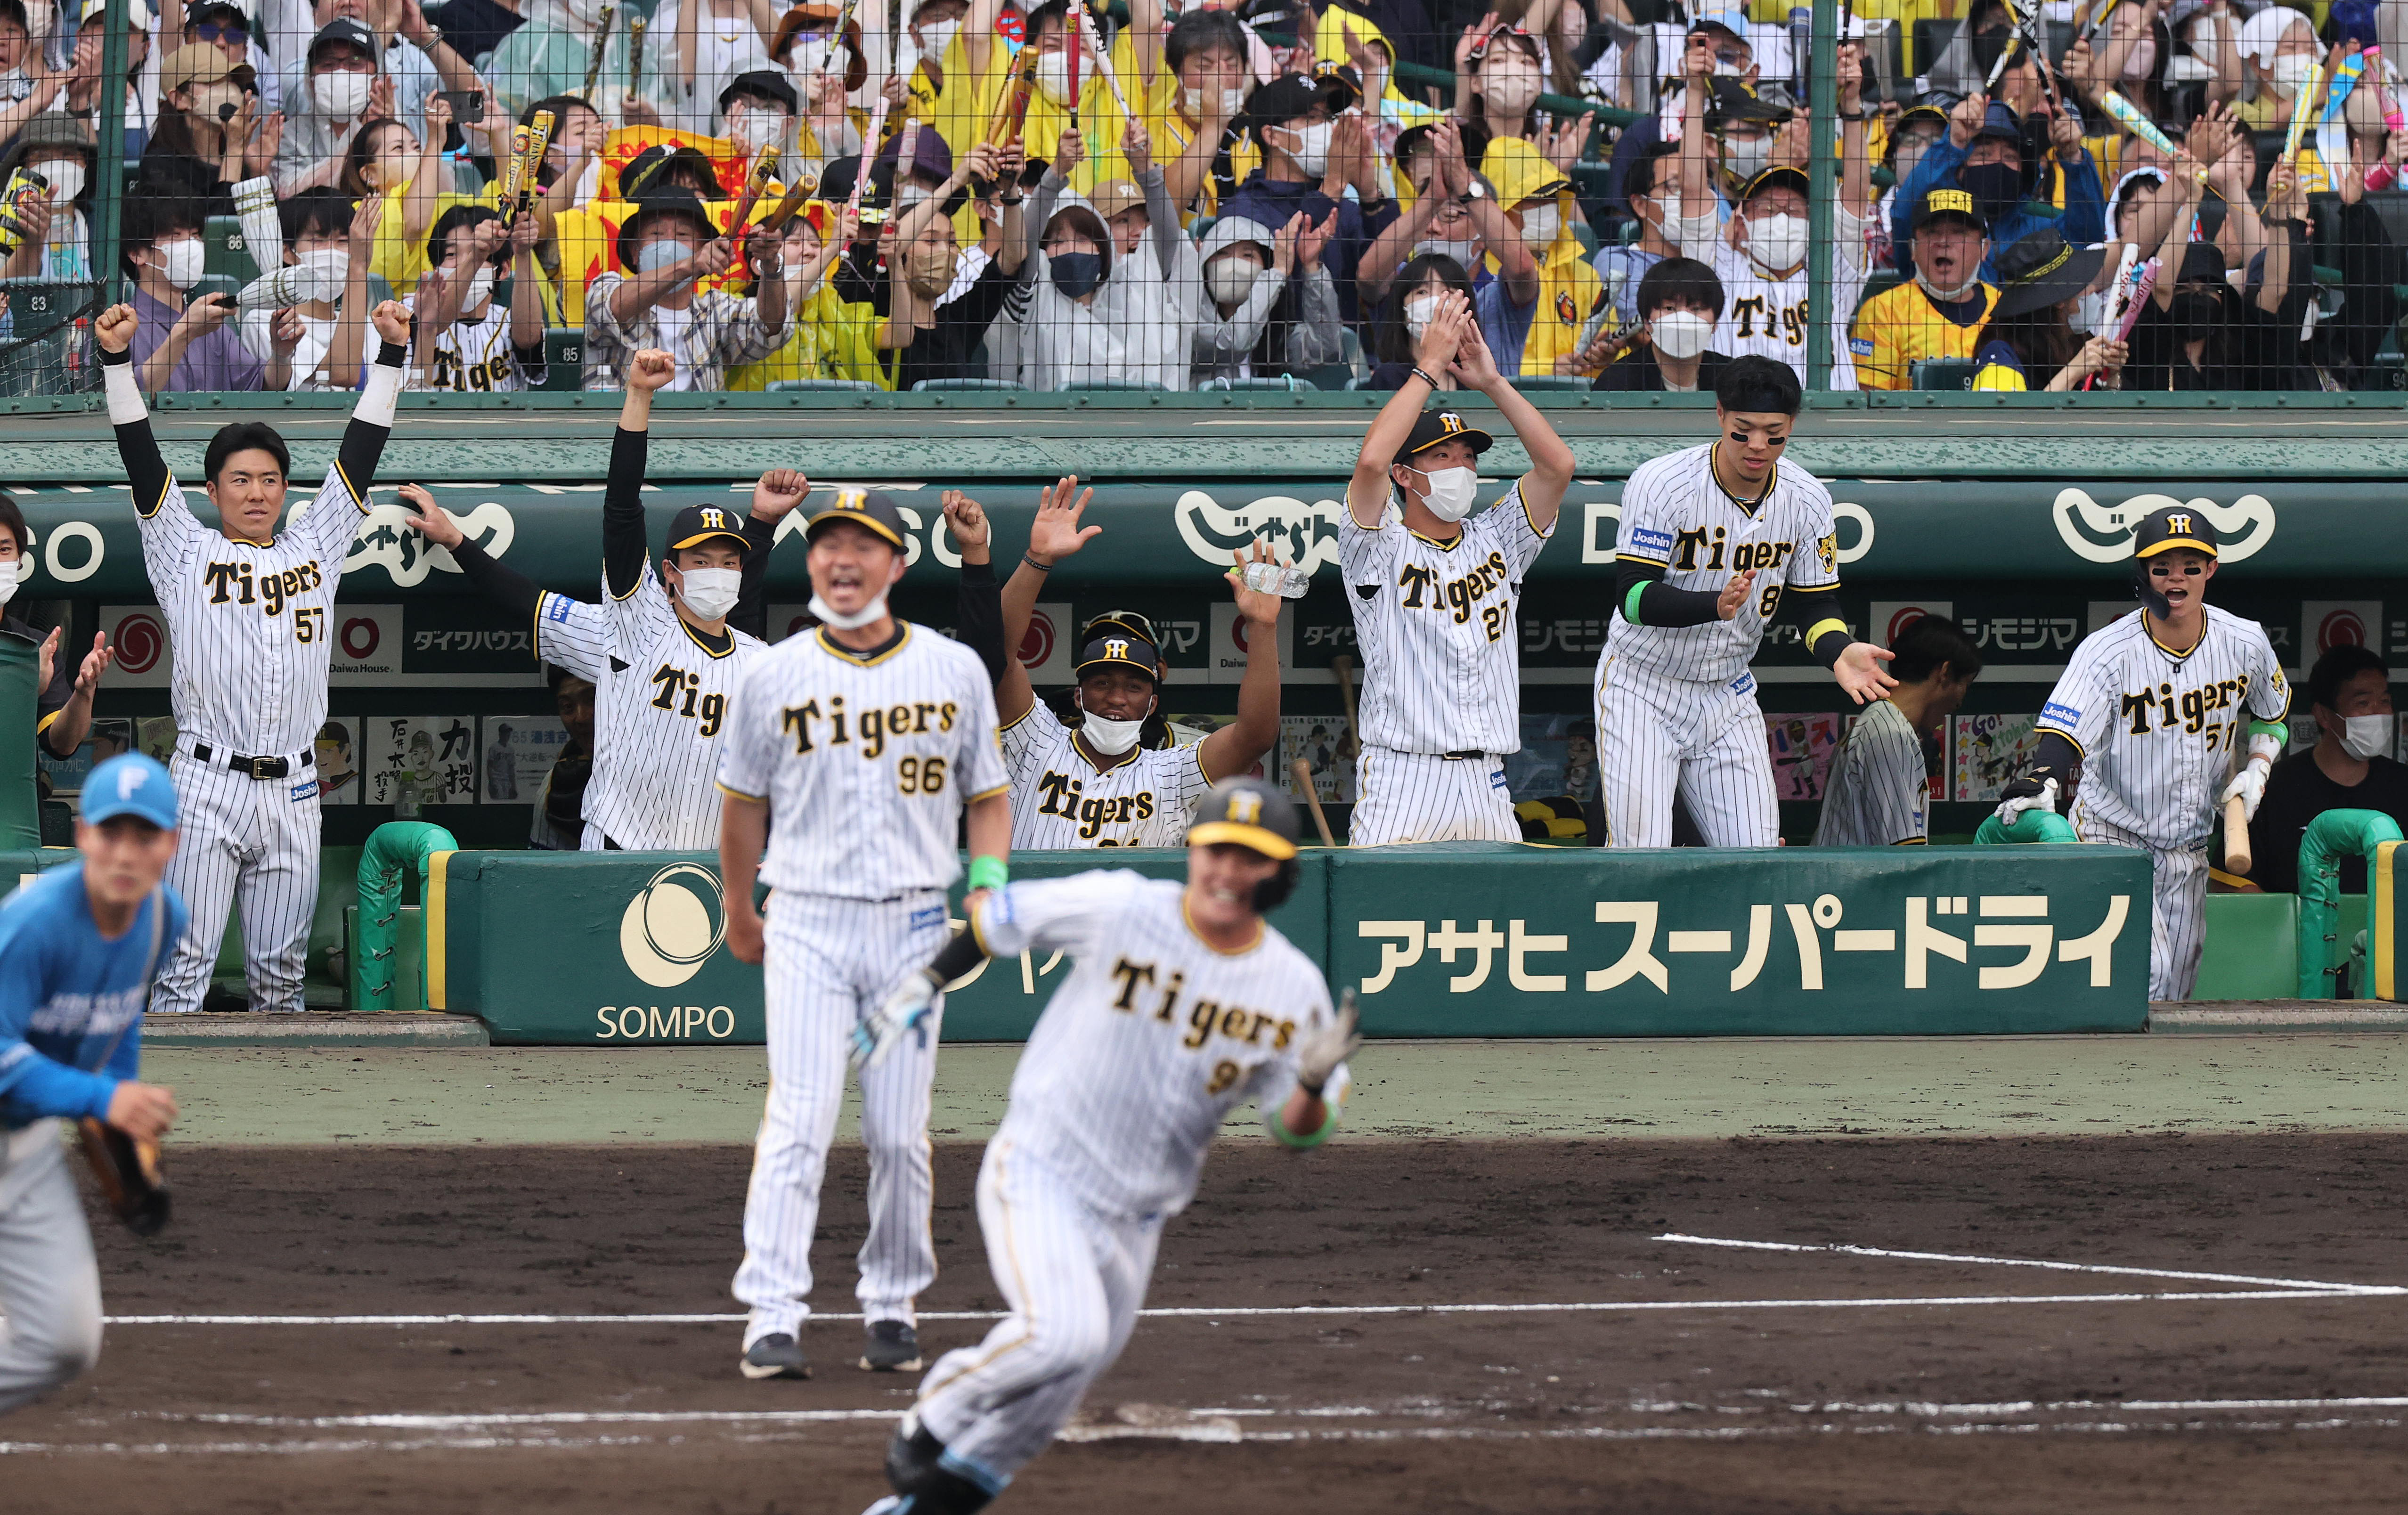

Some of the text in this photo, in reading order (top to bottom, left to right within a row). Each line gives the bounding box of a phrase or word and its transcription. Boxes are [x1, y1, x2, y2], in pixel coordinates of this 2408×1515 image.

[32, 296, 46, 310] 83
[562, 347, 578, 362] 85
[1634, 532, 1670, 548] Joshin
[1673, 526, 1793, 579] Tiger
[204, 560, 322, 616] Tigers
[1399, 552, 1506, 625] Tigers
[1760, 585, 1782, 619] 8
[295, 608, 324, 645] 57
[1482, 600, 1510, 644] 27
[1963, 618, 2077, 651] シモジマ
[414, 631, 530, 651] ダイワハウス
[330, 664, 390, 673] Daiwa House
[651, 663, 730, 738] Tig
[2044, 706, 2078, 724] Joshin
[2120, 674, 2248, 736] Tigers
[782, 697, 958, 758] Tigers
[2205, 720, 2237, 753] 51
[439, 718, 473, 795] 力投
[900, 757, 946, 794] 96
[1038, 770, 1154, 839] Tigers
[1357, 894, 2131, 994] アサヒスーパードライ
[1112, 954, 1295, 1050] Tigers
[596, 1005, 735, 1038] SOMPO
